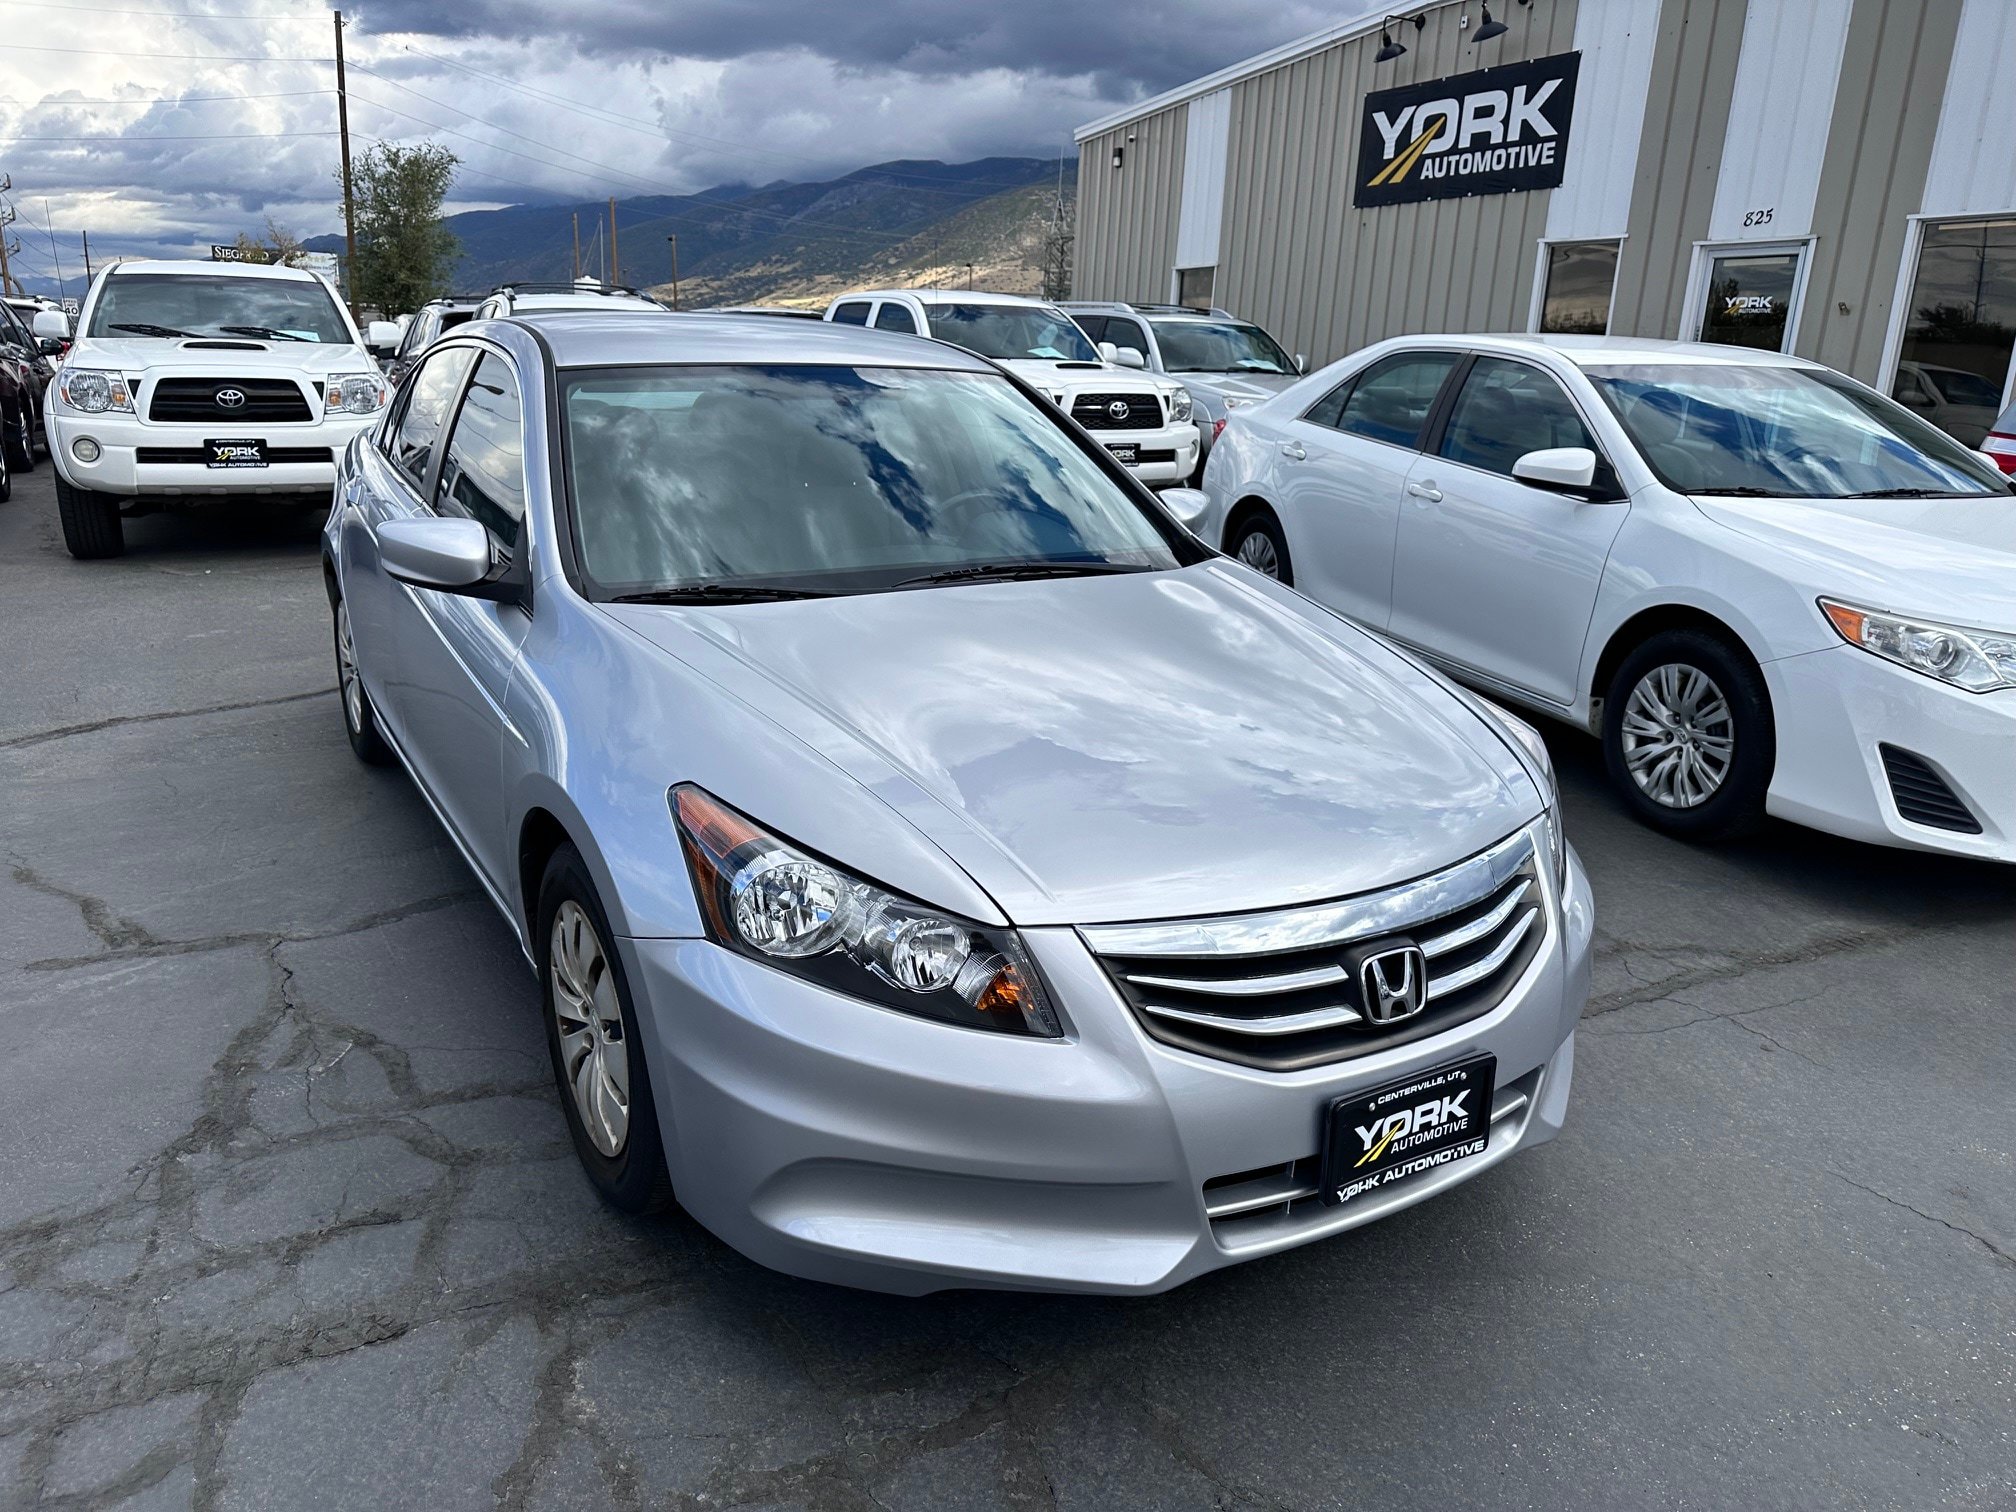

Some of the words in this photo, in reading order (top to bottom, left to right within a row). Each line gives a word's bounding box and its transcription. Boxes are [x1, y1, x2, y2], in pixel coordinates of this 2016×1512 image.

[1372, 78, 1564, 160] YORK
[1420, 141, 1556, 180] AUTOMOTIVE
[1743, 208, 1774, 227] 825
[65, 307, 78, 315] 40
[1725, 296, 1773, 308] YORK
[212, 446, 260, 455] YORK
[1377, 1077, 1446, 1105] CENTERVILLE,
[1447, 1070, 1461, 1082] UT
[1354, 1088, 1471, 1151] YORK
[1390, 1117, 1469, 1154] AUTOMOTIVE
[1382, 1139, 1486, 1184] AUTOMOTIVE
